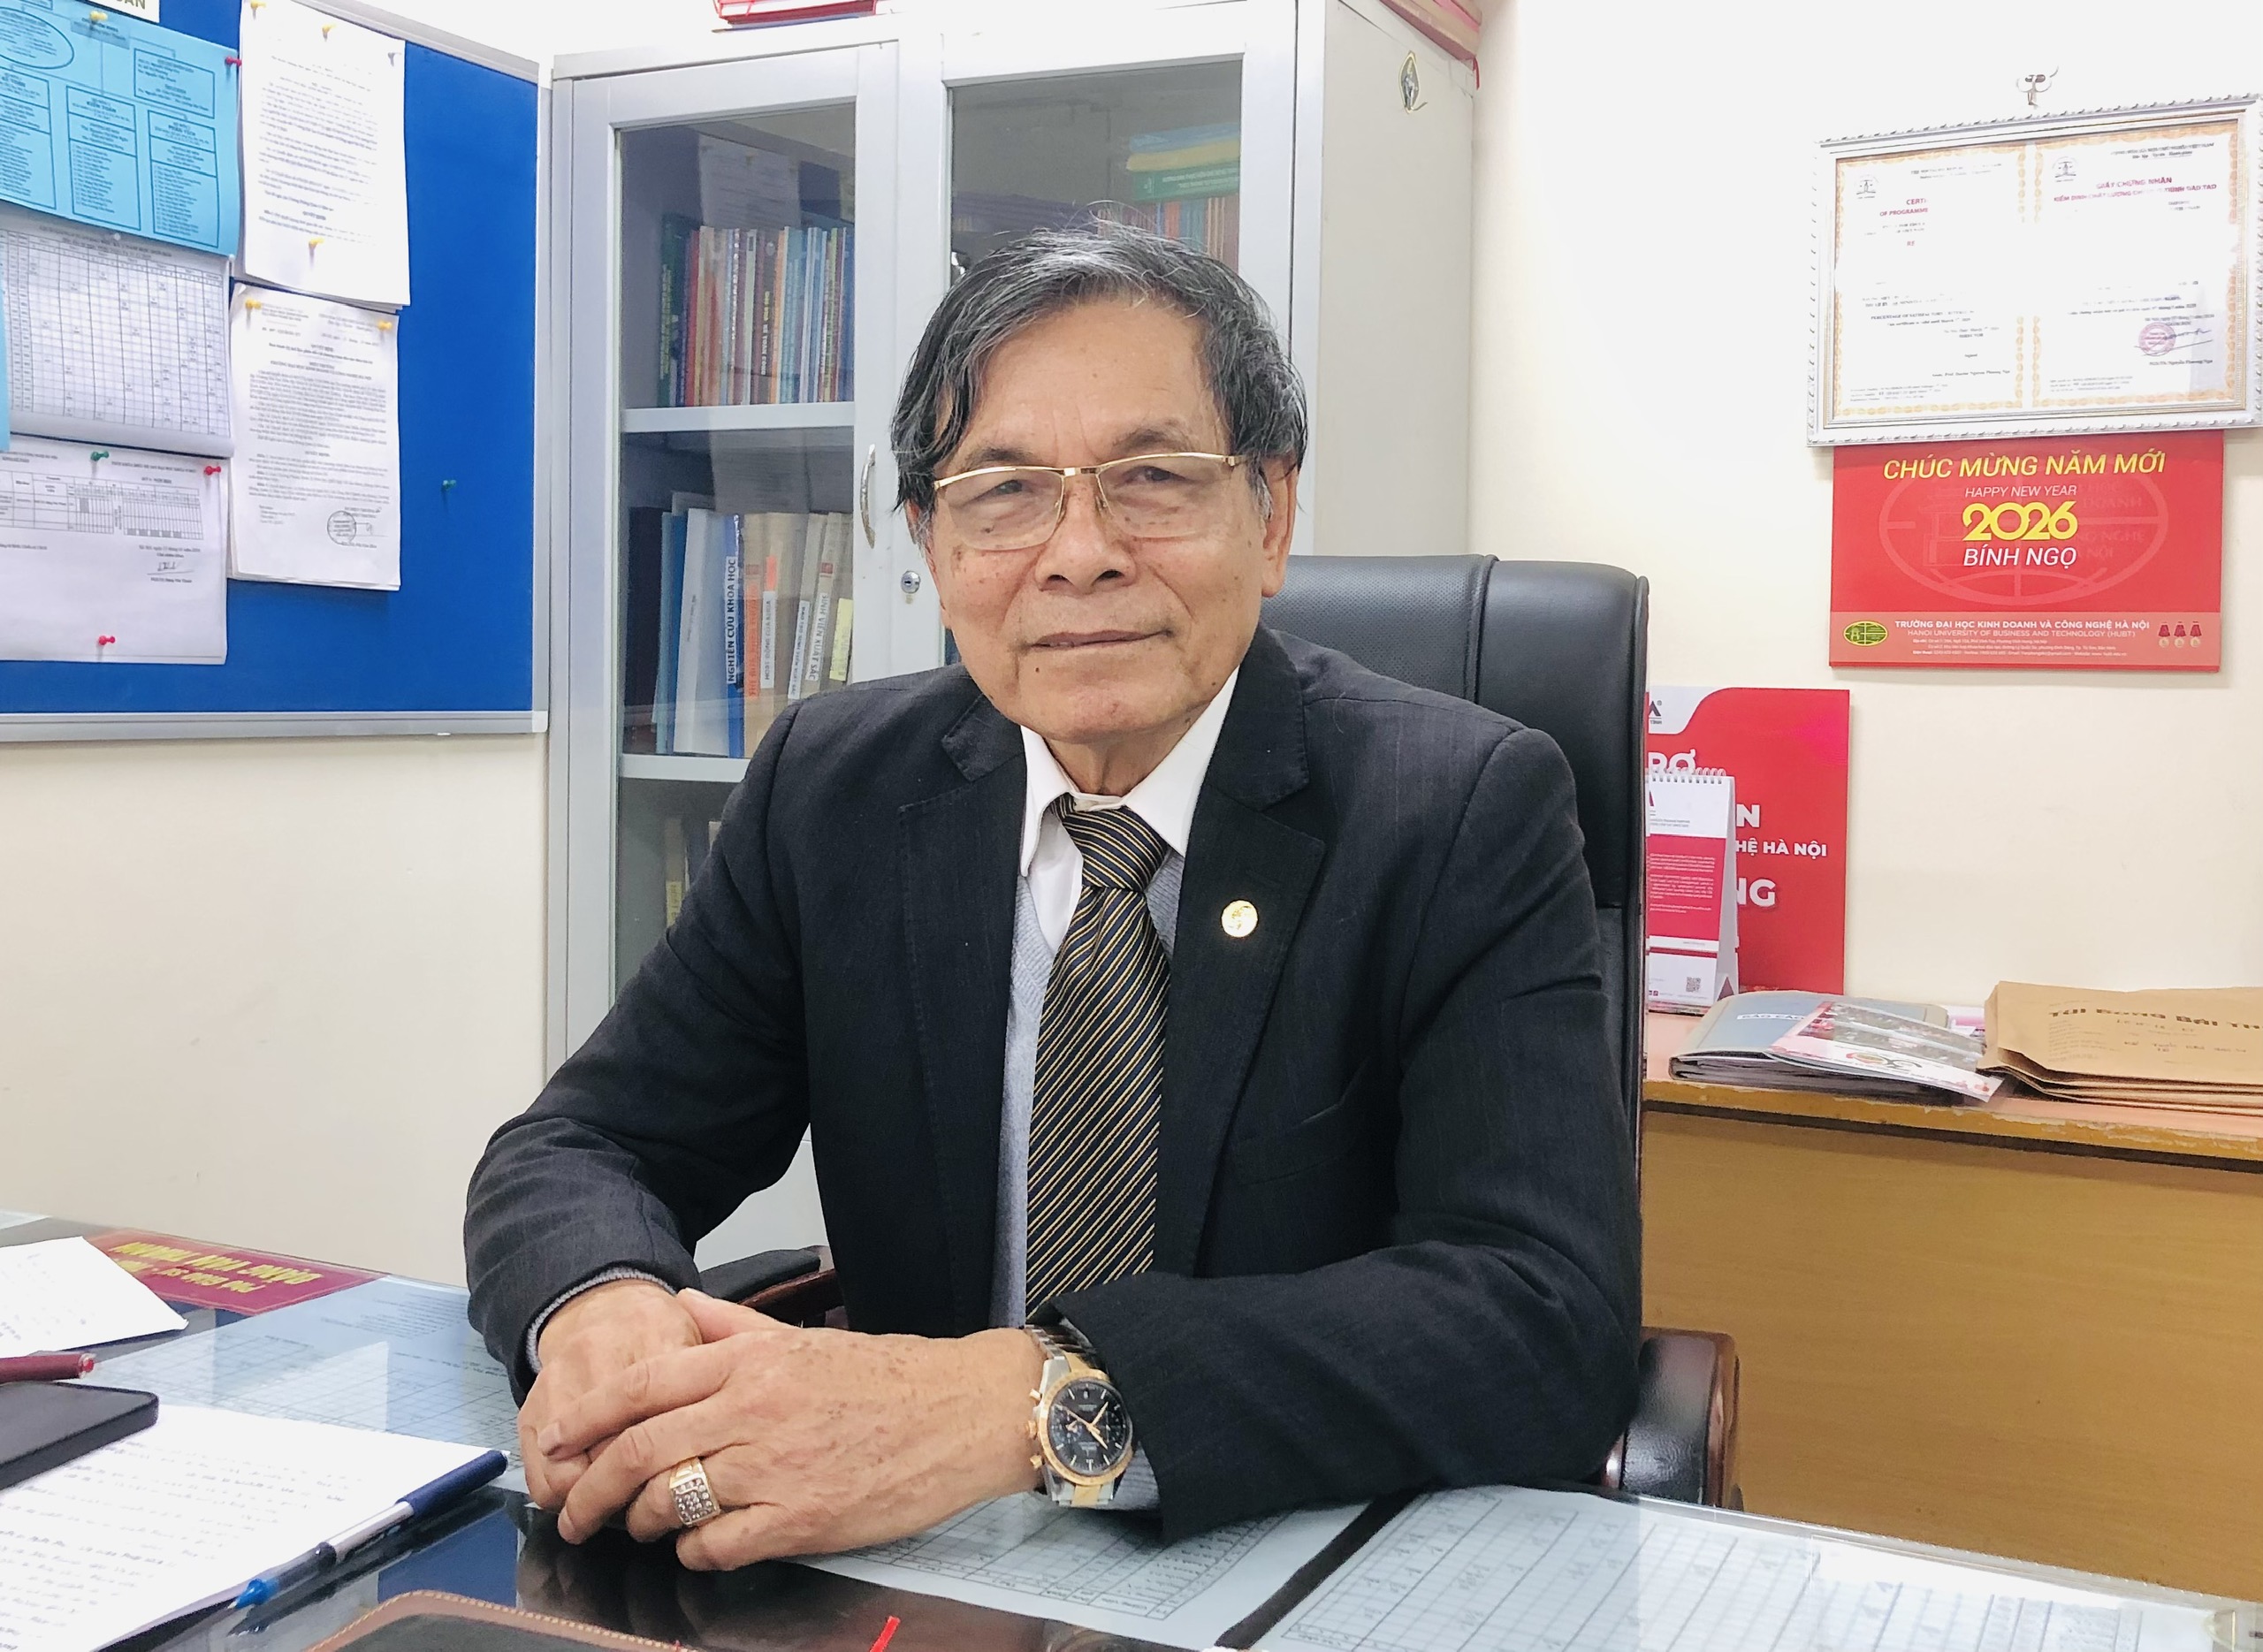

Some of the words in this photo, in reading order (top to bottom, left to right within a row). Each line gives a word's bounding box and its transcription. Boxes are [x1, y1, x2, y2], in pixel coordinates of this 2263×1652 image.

[1883, 454, 1953, 479] CHÚC
[1959, 453, 2038, 477] MỪNG
[2045, 450, 2107, 476] NĂM
[2113, 450, 2167, 474] MỚI
[1964, 486, 2010, 498] HAPPY
[2010, 485, 2042, 497] NEW
[2045, 485, 2077, 496] YEAR
[1962, 501, 2078, 541] 2026
[1962, 544, 2019, 566] BÍNH
[2025, 547, 2077, 569] NGỌ
[727, 559, 736, 582] HỌC
[1895, 619, 1933, 628] TRƯỜNG
[1936, 620, 1952, 629] ĐẠI
[1954, 620, 1975, 630] HỌC
[2039, 620, 2052, 628] VÀ
[2054, 620, 2083, 628] CÔNG
[2085, 620, 2112, 630] NGHỆ
[2114, 620, 2129, 628] HÀ
[2131, 620, 2150, 631] NỘI
[1763, 838, 1789, 855] HÀ
[1794, 841, 1826, 859] NỘI
